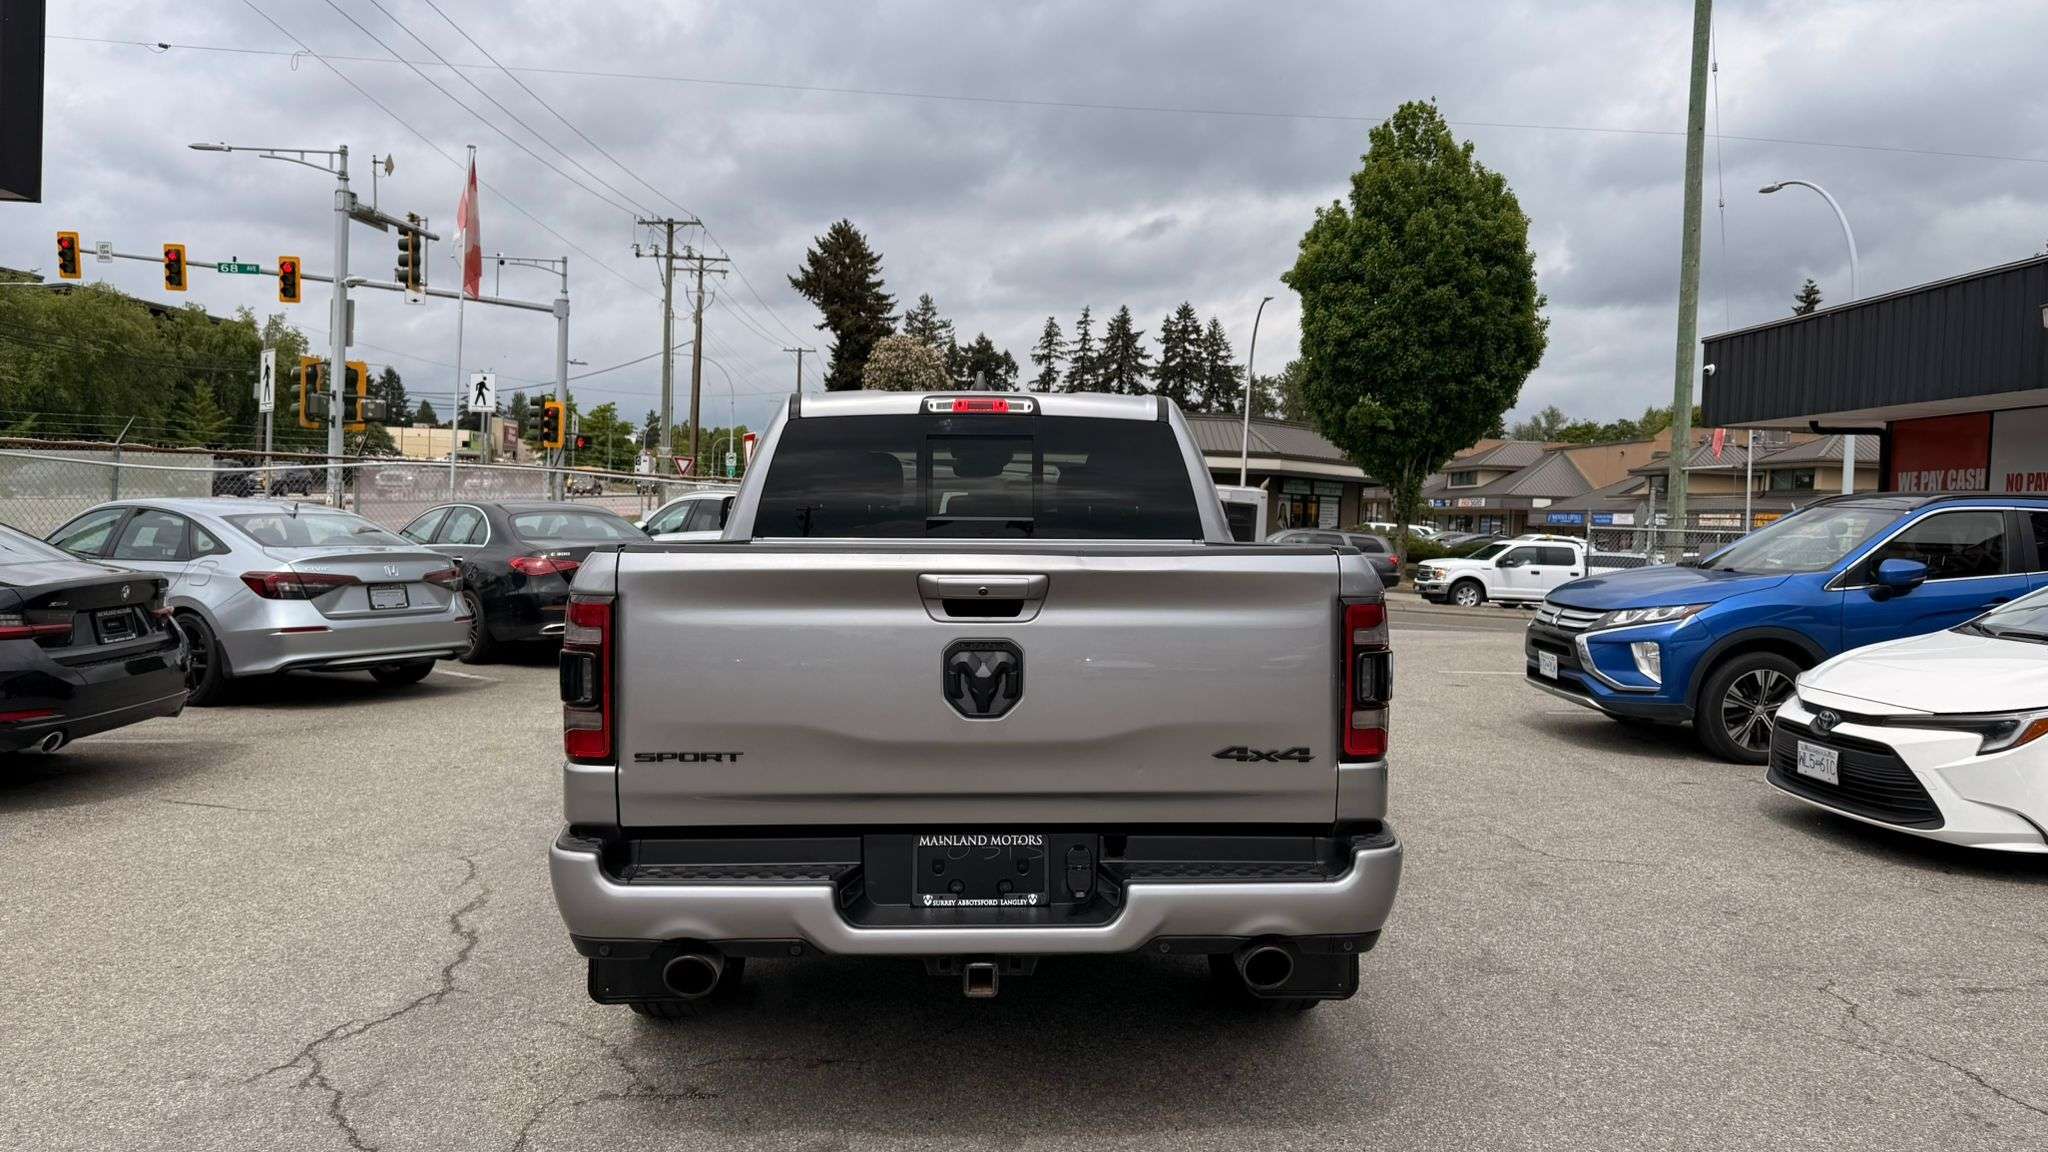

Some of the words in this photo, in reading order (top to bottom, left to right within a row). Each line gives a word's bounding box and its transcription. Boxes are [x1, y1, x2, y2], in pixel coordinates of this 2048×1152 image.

[220, 264, 238, 272] 68
[1898, 471, 1918, 493] WE
[1920, 470, 1945, 492] PAY
[1947, 468, 1986, 491] CASH
[2005, 473, 2023, 492] NO
[634, 752, 744, 762] SPORT
[919, 835, 987, 846] MAINLAND
[990, 835, 1042, 846] MOTORS
